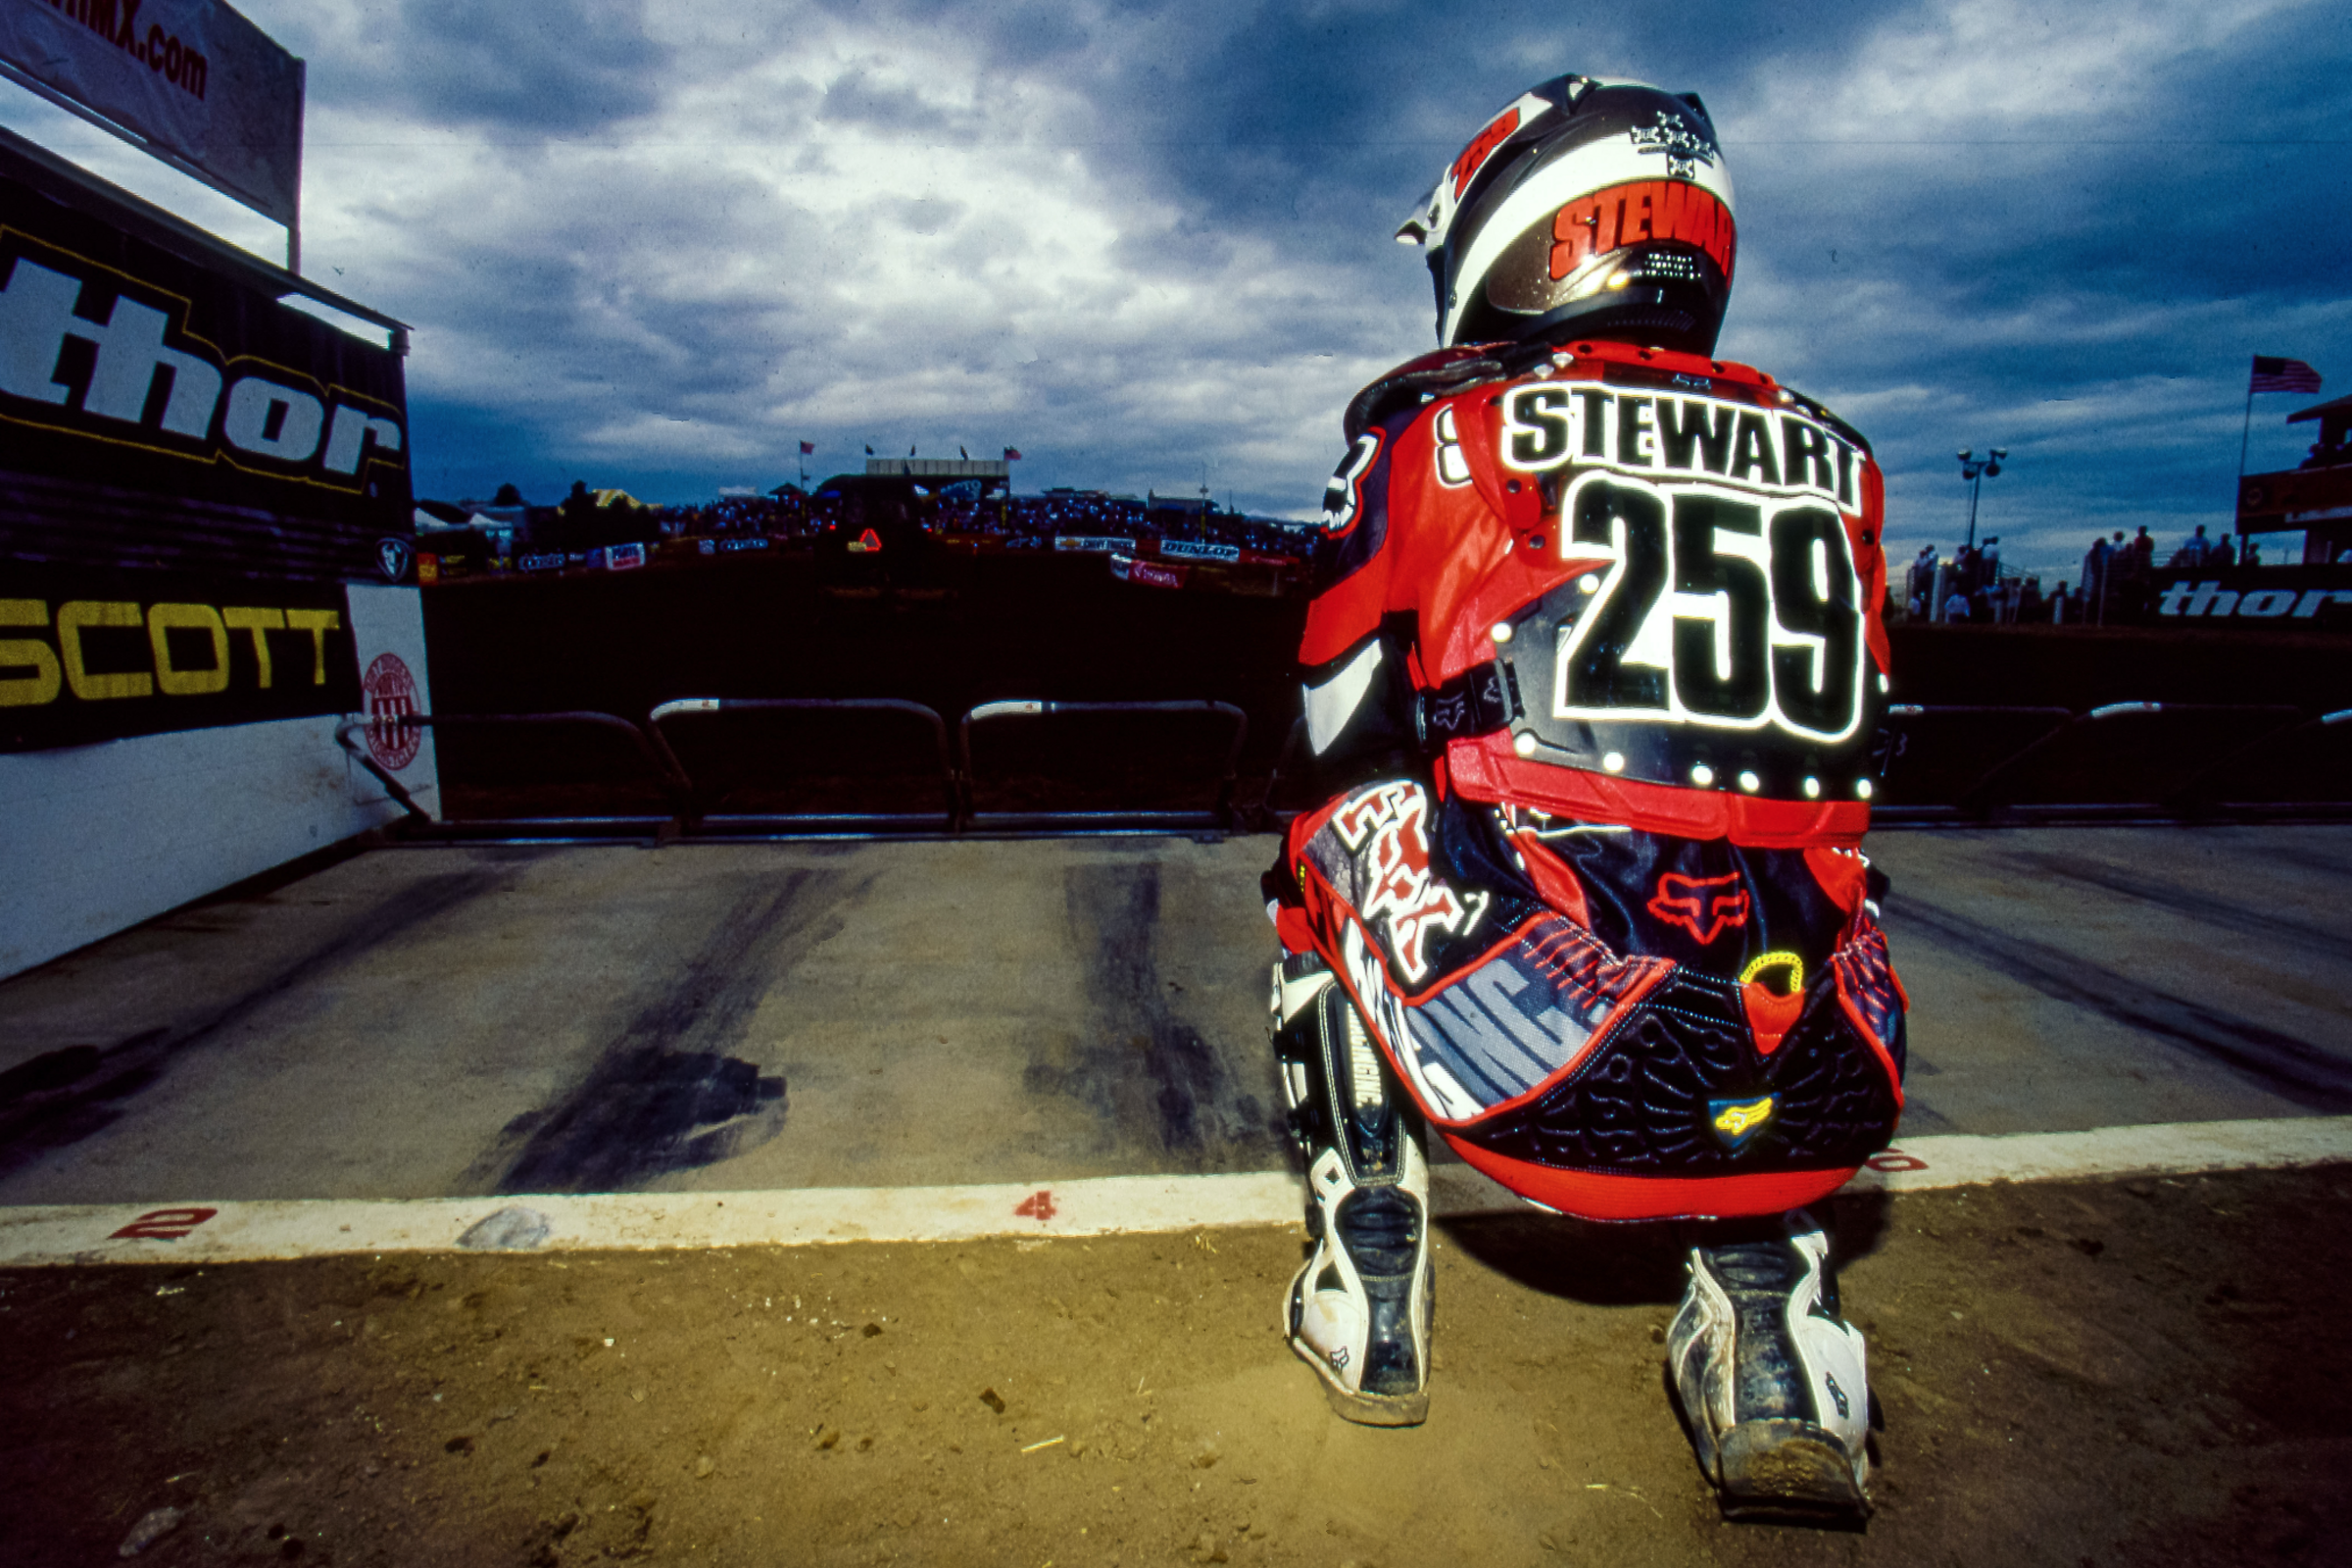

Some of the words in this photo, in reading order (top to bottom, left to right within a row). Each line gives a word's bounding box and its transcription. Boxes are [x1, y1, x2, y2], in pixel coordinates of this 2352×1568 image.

[1548, 180, 1735, 281] STEWAR
[0, 257, 402, 475] thor
[1501, 381, 1863, 515] STEWART
[1164, 542, 1237, 557] DUNLOP
[2159, 580, 2352, 618] thor
[0, 599, 340, 708] SCOTT
[1553, 469, 1865, 742] 259
[107, 1207, 219, 1241] 2
[1014, 1190, 1058, 1220] 4
